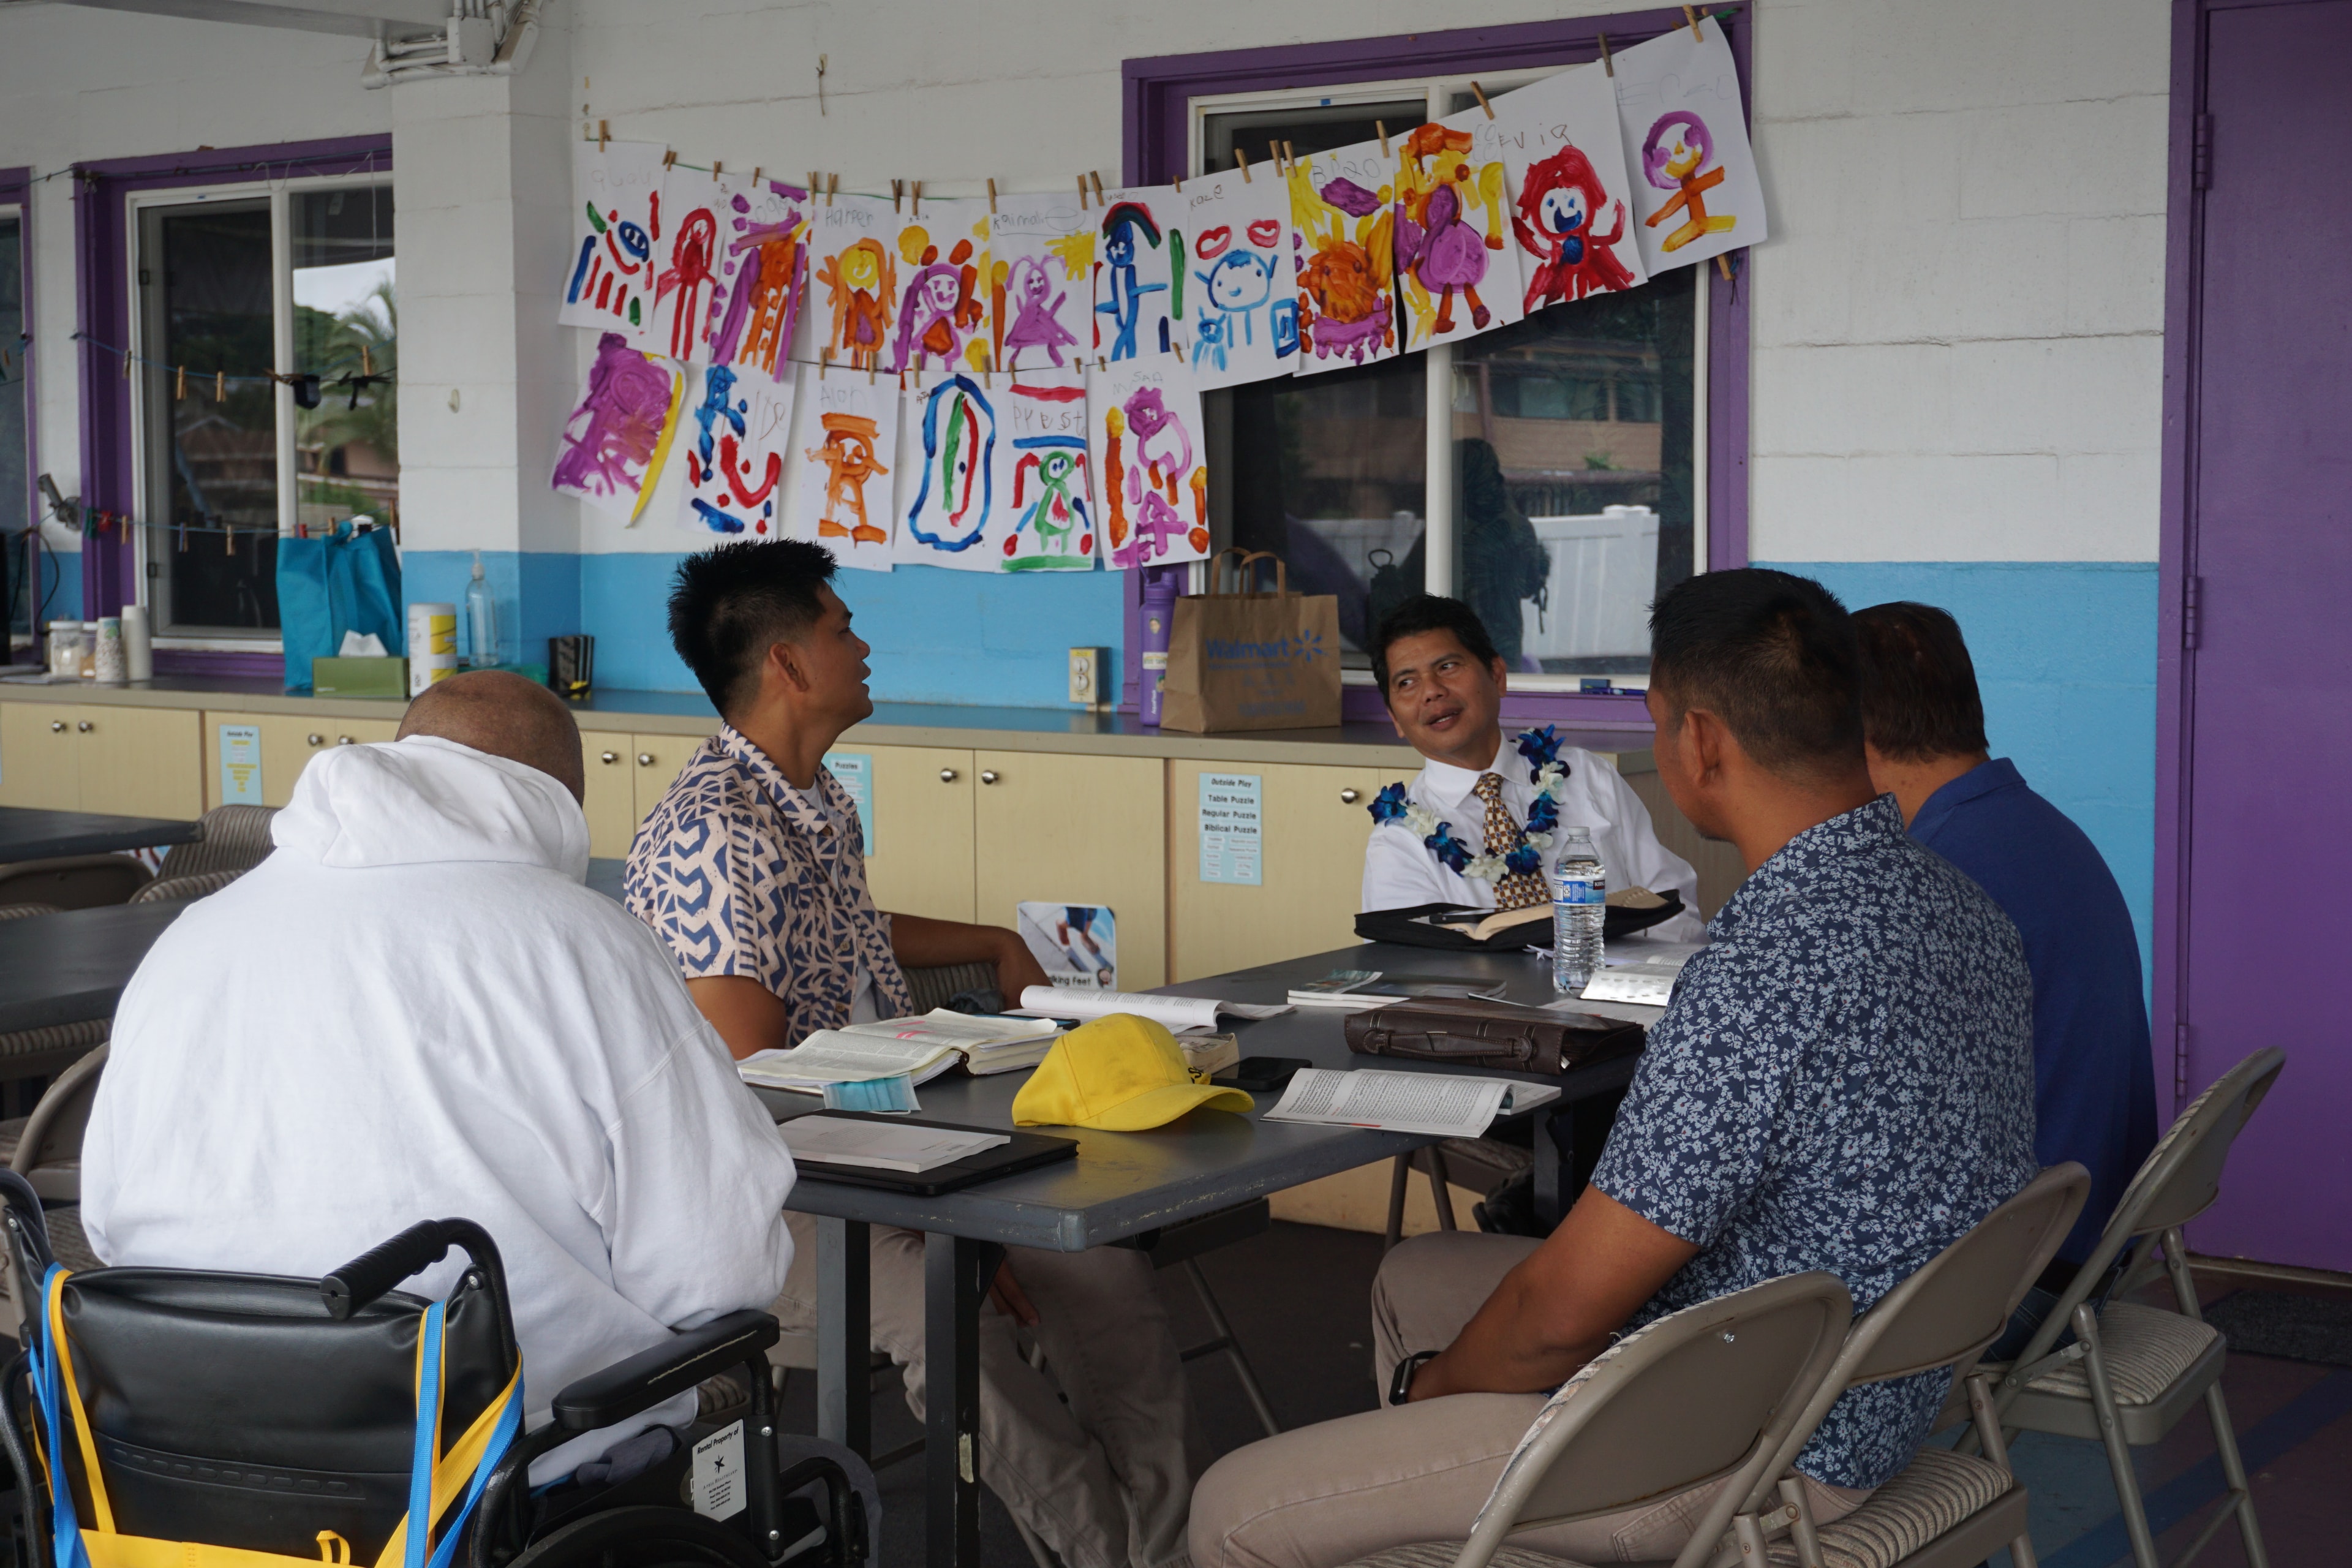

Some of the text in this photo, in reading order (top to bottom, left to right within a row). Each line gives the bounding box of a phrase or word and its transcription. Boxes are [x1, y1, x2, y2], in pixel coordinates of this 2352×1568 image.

[1205, 638, 1290, 659] Walmart
[1202, 809, 1257, 820] Regular Puzzle
[697, 1426, 739, 1455] Rental Property of
